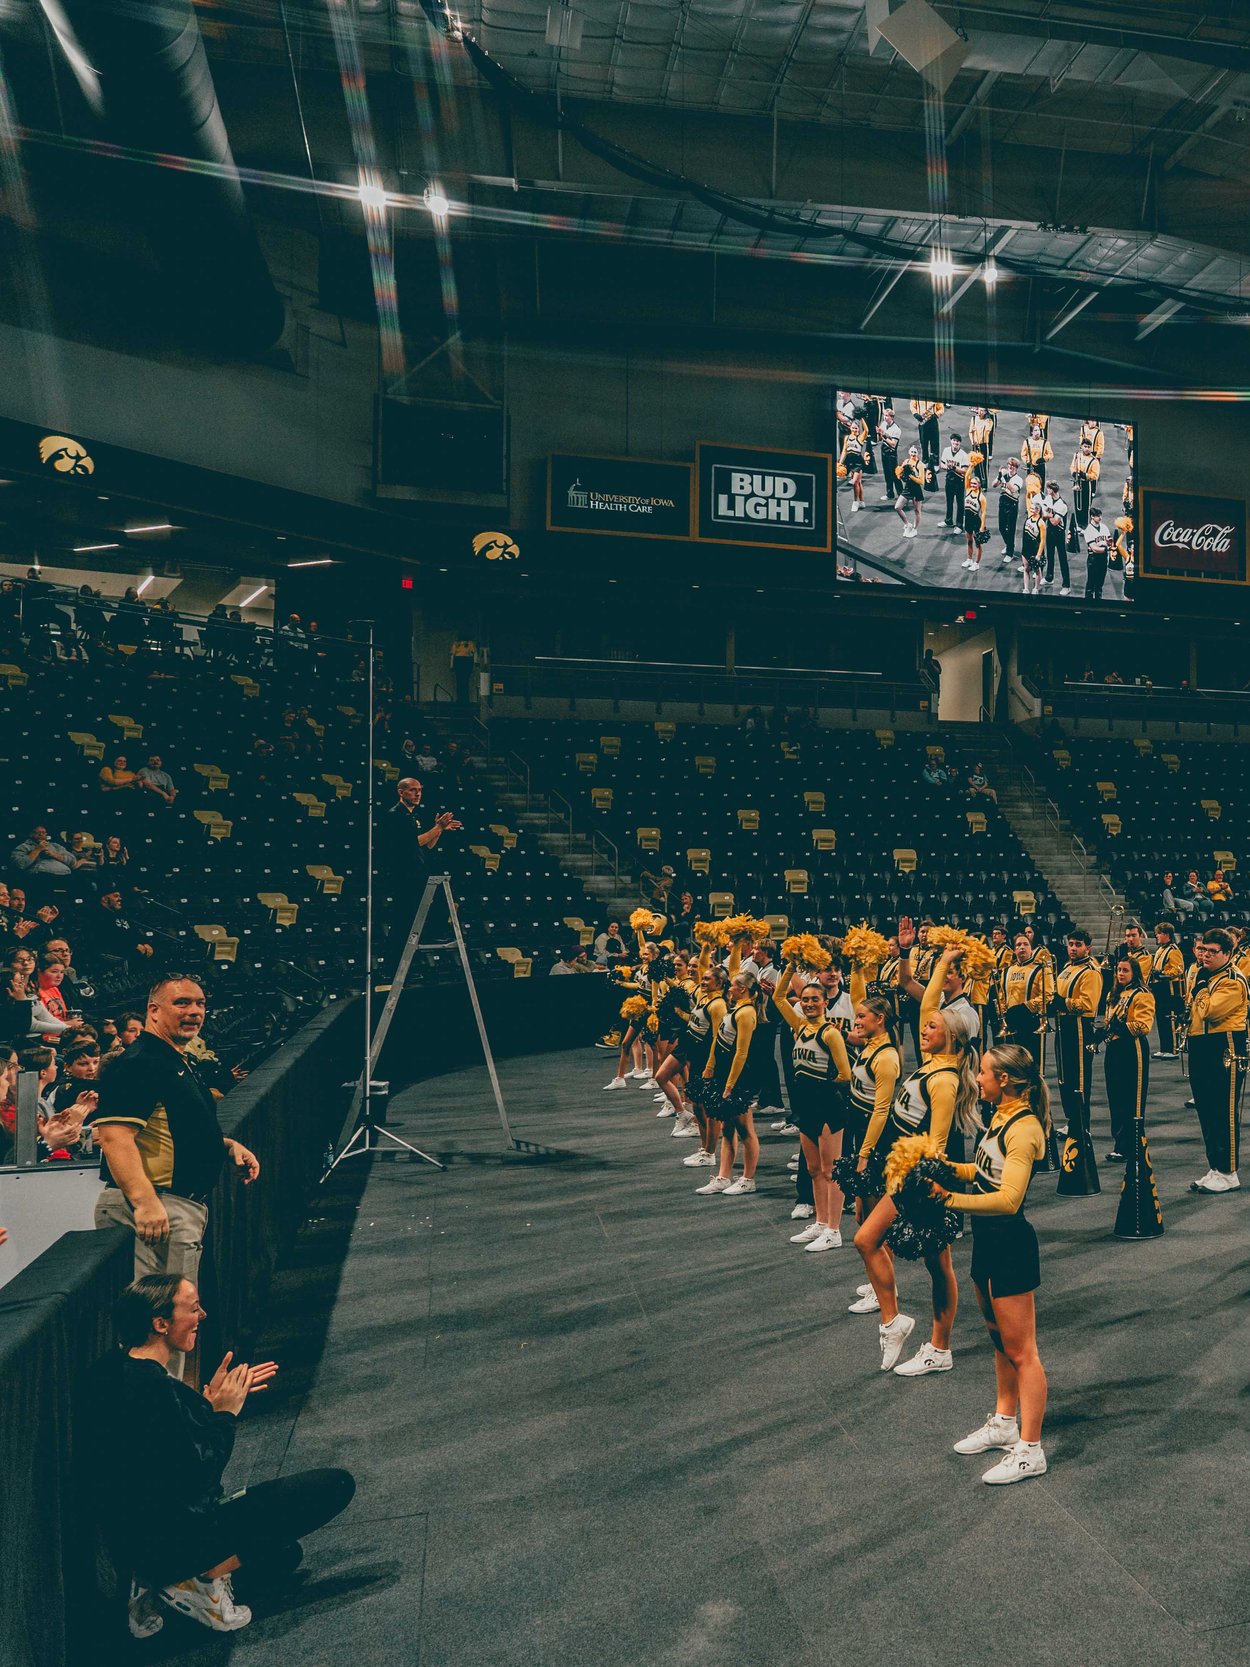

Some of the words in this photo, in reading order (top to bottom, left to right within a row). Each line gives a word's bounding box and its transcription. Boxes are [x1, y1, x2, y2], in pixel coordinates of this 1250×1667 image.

[731, 472, 797, 499] BUD
[590, 492, 641, 505] UNIVERSITY
[651, 497, 675, 508] IOWA
[590, 501, 627, 512] HEALTH
[629, 504, 653, 514] CARE
[1154, 519, 1236, 553] Coca-Cola
